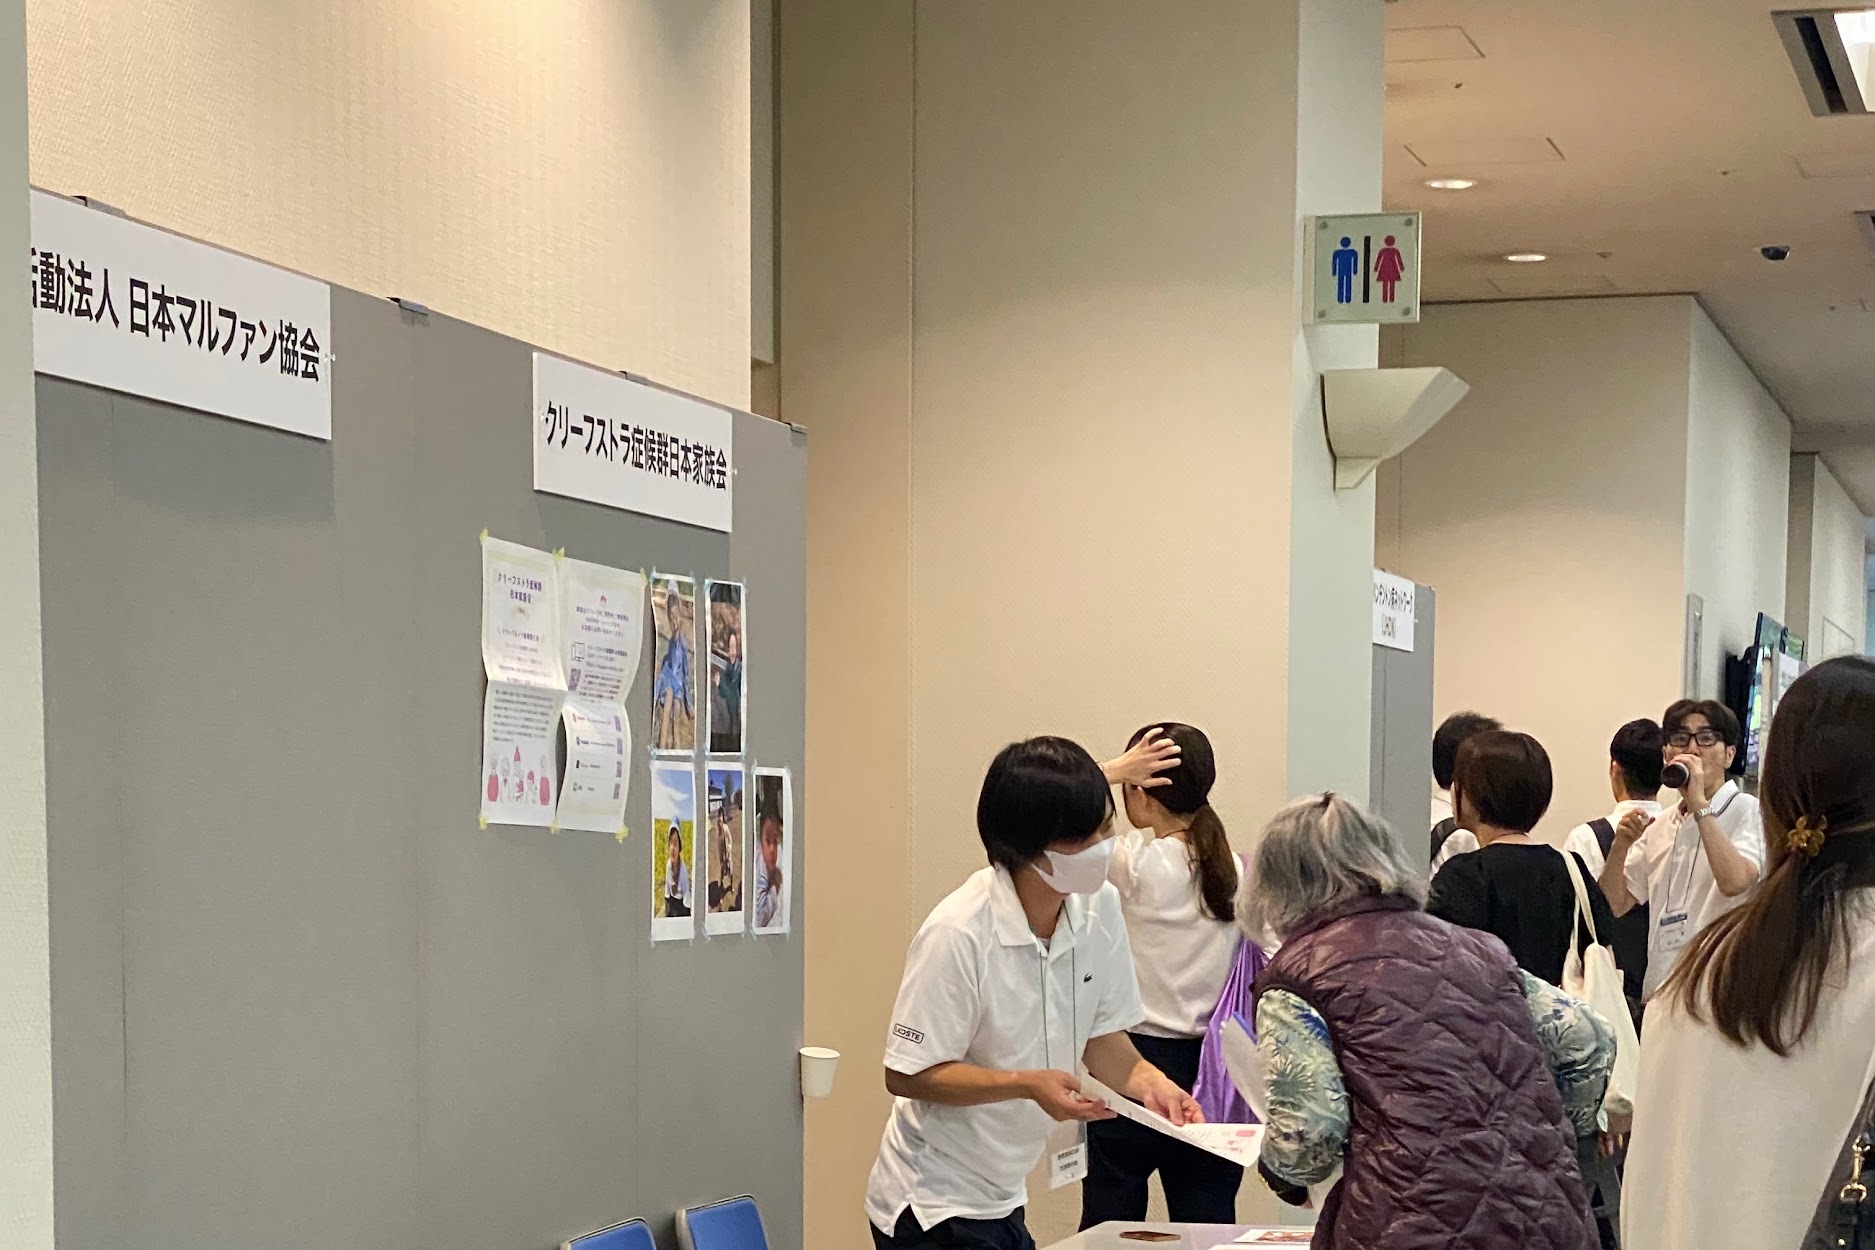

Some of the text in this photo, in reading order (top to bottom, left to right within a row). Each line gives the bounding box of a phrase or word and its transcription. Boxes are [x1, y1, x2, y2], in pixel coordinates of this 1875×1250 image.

[31, 247, 320, 382] 動法人 日本マルファン協会
[545, 400, 727, 490] クリーフストラ症候群日本家族会
